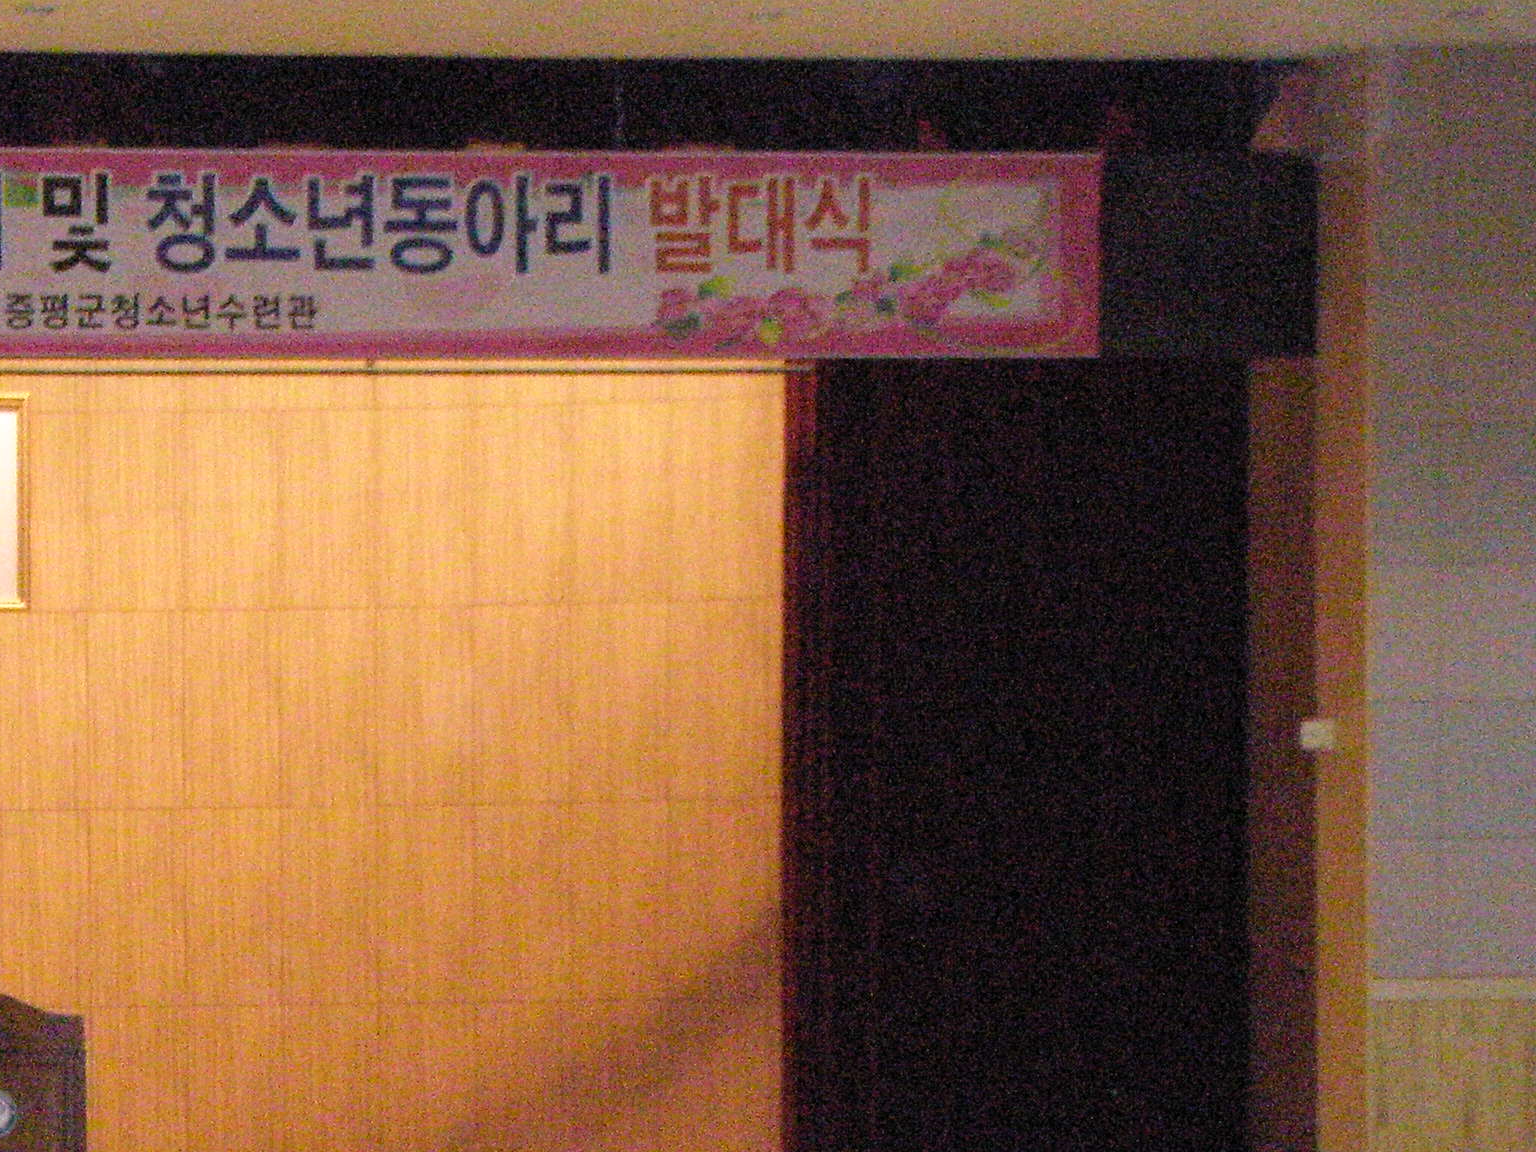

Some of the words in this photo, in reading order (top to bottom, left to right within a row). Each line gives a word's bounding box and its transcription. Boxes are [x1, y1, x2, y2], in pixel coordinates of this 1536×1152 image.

[42, 173, 112, 272] 및
[146, 172, 610, 274] 청소년동아리
[650, 175, 870, 274] 발대식
[6, 293, 317, 331] 증평군청소년수련관
